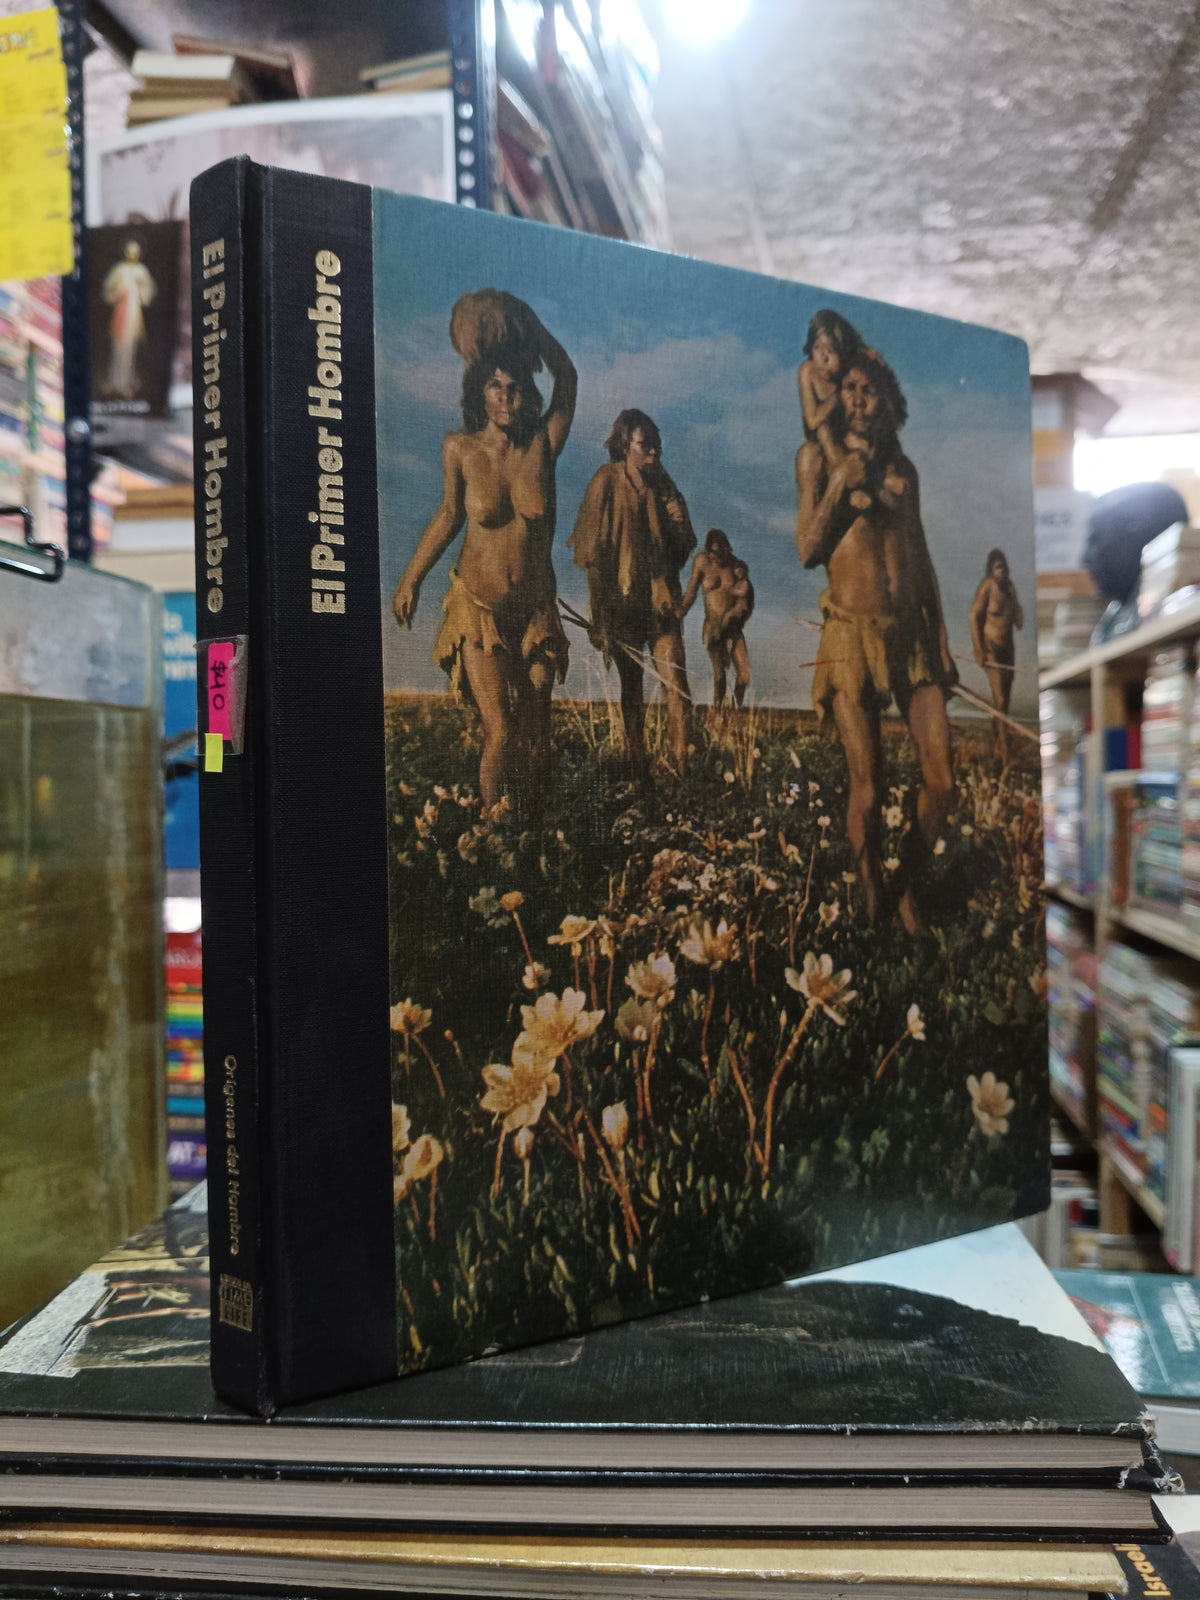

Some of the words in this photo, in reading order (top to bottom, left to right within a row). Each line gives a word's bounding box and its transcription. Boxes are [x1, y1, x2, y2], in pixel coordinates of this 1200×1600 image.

[202, 237, 225, 280] El
[202, 280, 227, 430] Primer
[307, 249, 343, 420] Hombre
[204, 435, 229, 613] Hombre
[307, 426, 346, 572] Primer
[311, 577, 346, 615] El
[210, 660, 228, 710] $40
[228, 1180, 242, 1255] Hombre
[223, 1303, 250, 1328] LIFE
